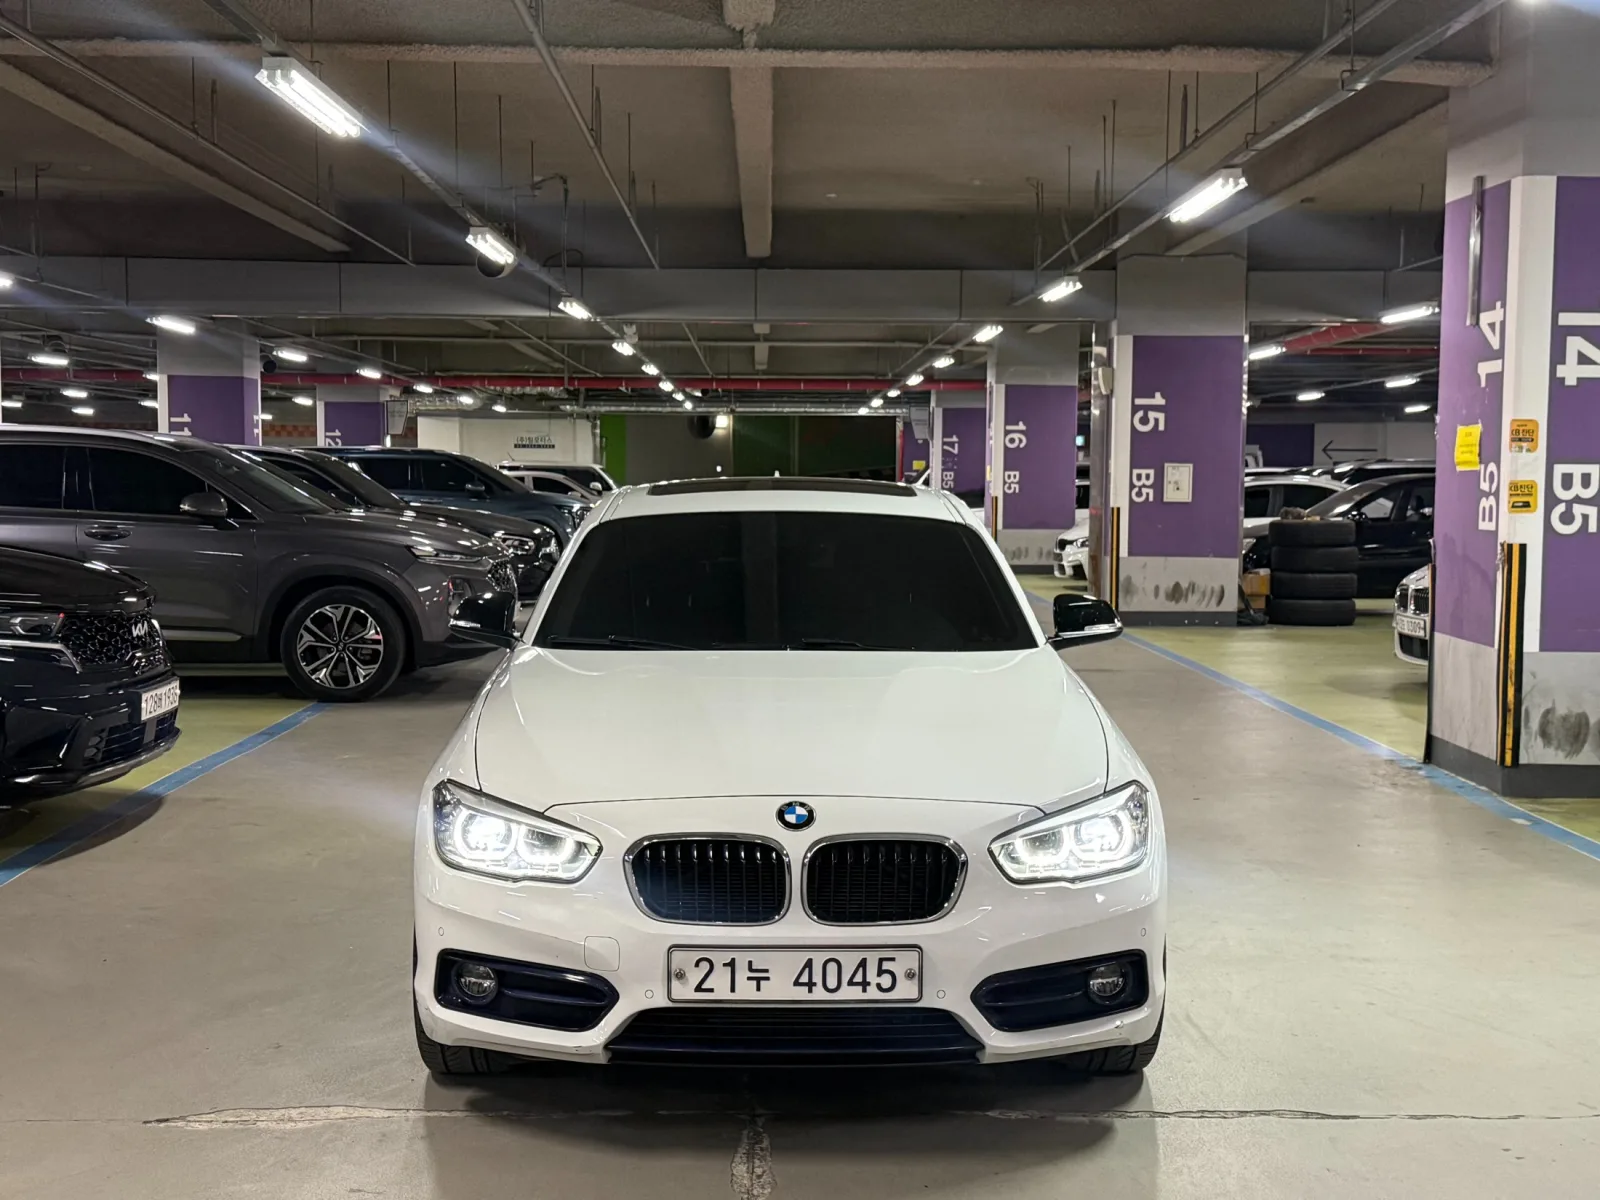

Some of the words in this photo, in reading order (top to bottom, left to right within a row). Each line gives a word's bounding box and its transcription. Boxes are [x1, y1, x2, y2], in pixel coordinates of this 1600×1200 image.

[1477, 301, 1505, 387] 14
[1556, 312, 1600, 386] 14
[169, 413, 192, 437] 11
[1133, 391, 1166, 432] 15
[325, 428, 342, 447] 12
[943, 434, 959, 455] 17
[1004, 421, 1027, 449] 16
[942, 471, 954, 489] B5
[1004, 471, 1020, 494] B5
[1131, 468, 1155, 503] B5
[1477, 461, 1499, 531] B5
[1550, 464, 1600, 535] B5
[693, 956, 771, 993] 21누
[792, 956, 898, 994] 4045
